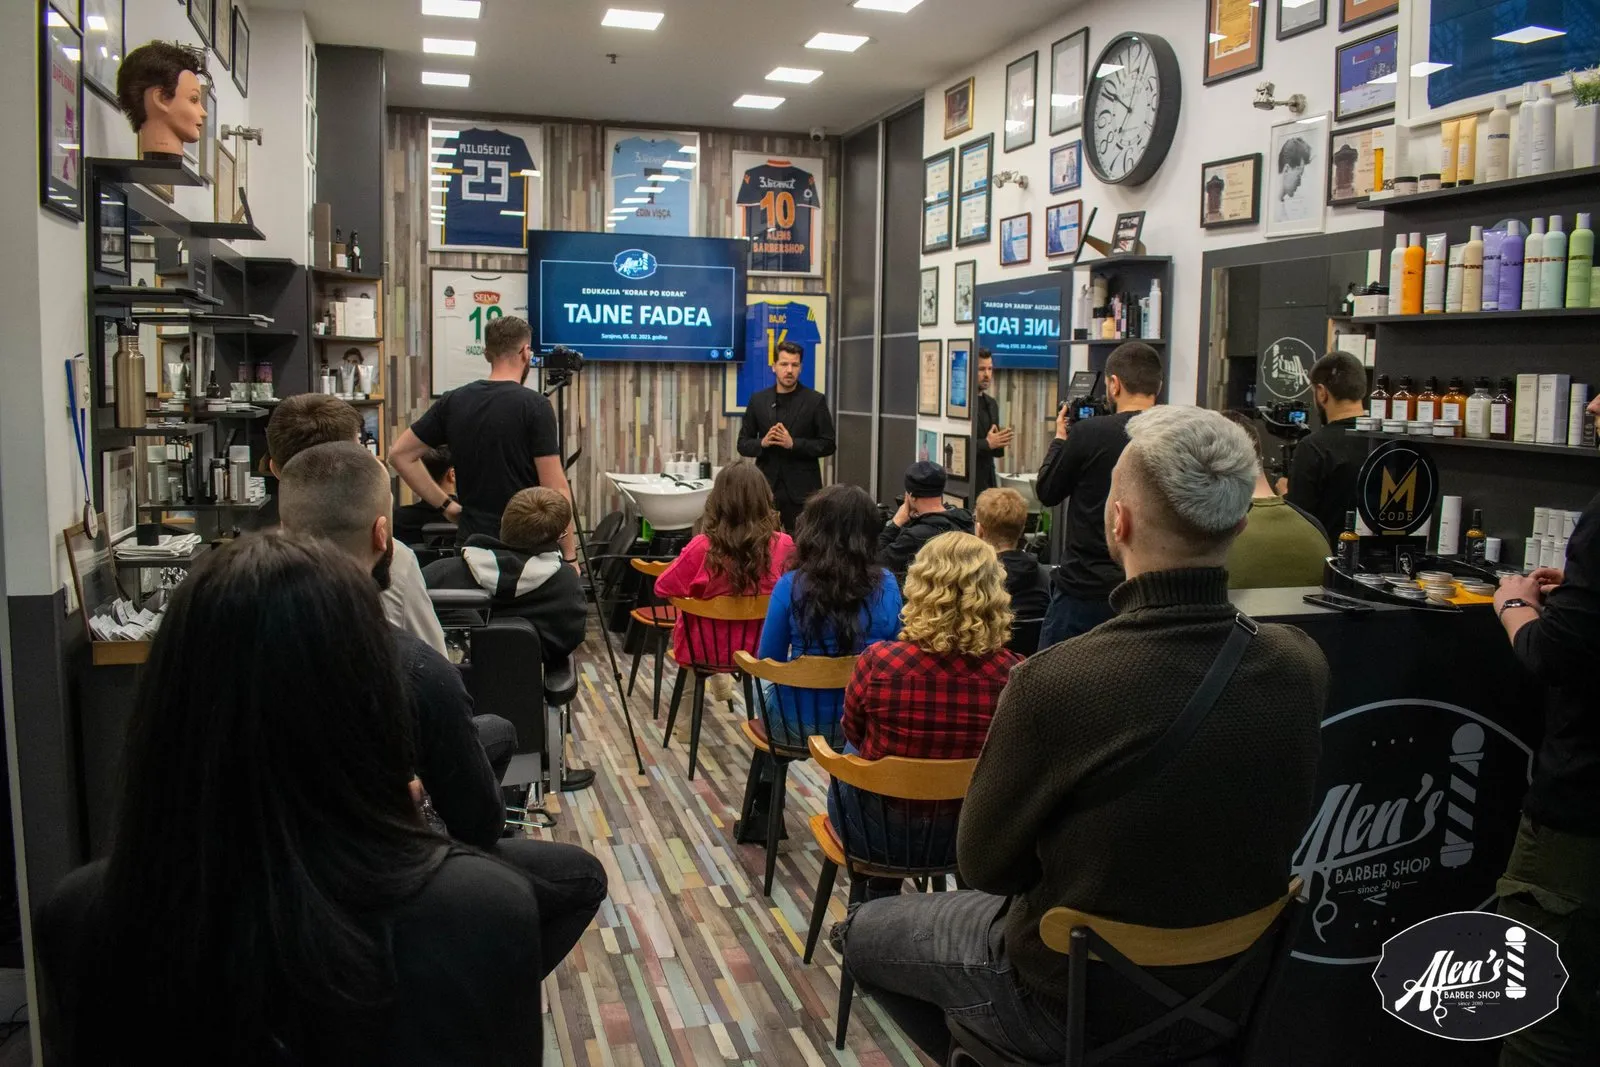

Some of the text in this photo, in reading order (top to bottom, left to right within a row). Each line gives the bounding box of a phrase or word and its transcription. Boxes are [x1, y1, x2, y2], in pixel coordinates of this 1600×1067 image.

[53, 63, 76, 97] DIPLOMA
[462, 159, 509, 202] 23
[760, 191, 795, 229] 10
[753, 243, 804, 253] BARBERSHOP
[582, 288, 620, 296] EDUKACIJA
[564, 303, 712, 327] TAJNE FADEA
[1380, 459, 1418, 511] M
[1379, 512, 1413, 521] CODE
[1291, 773, 1444, 899] Alen's
[1335, 857, 1431, 884] BARBER SHOP
[1357, 879, 1400, 894] since 2010
